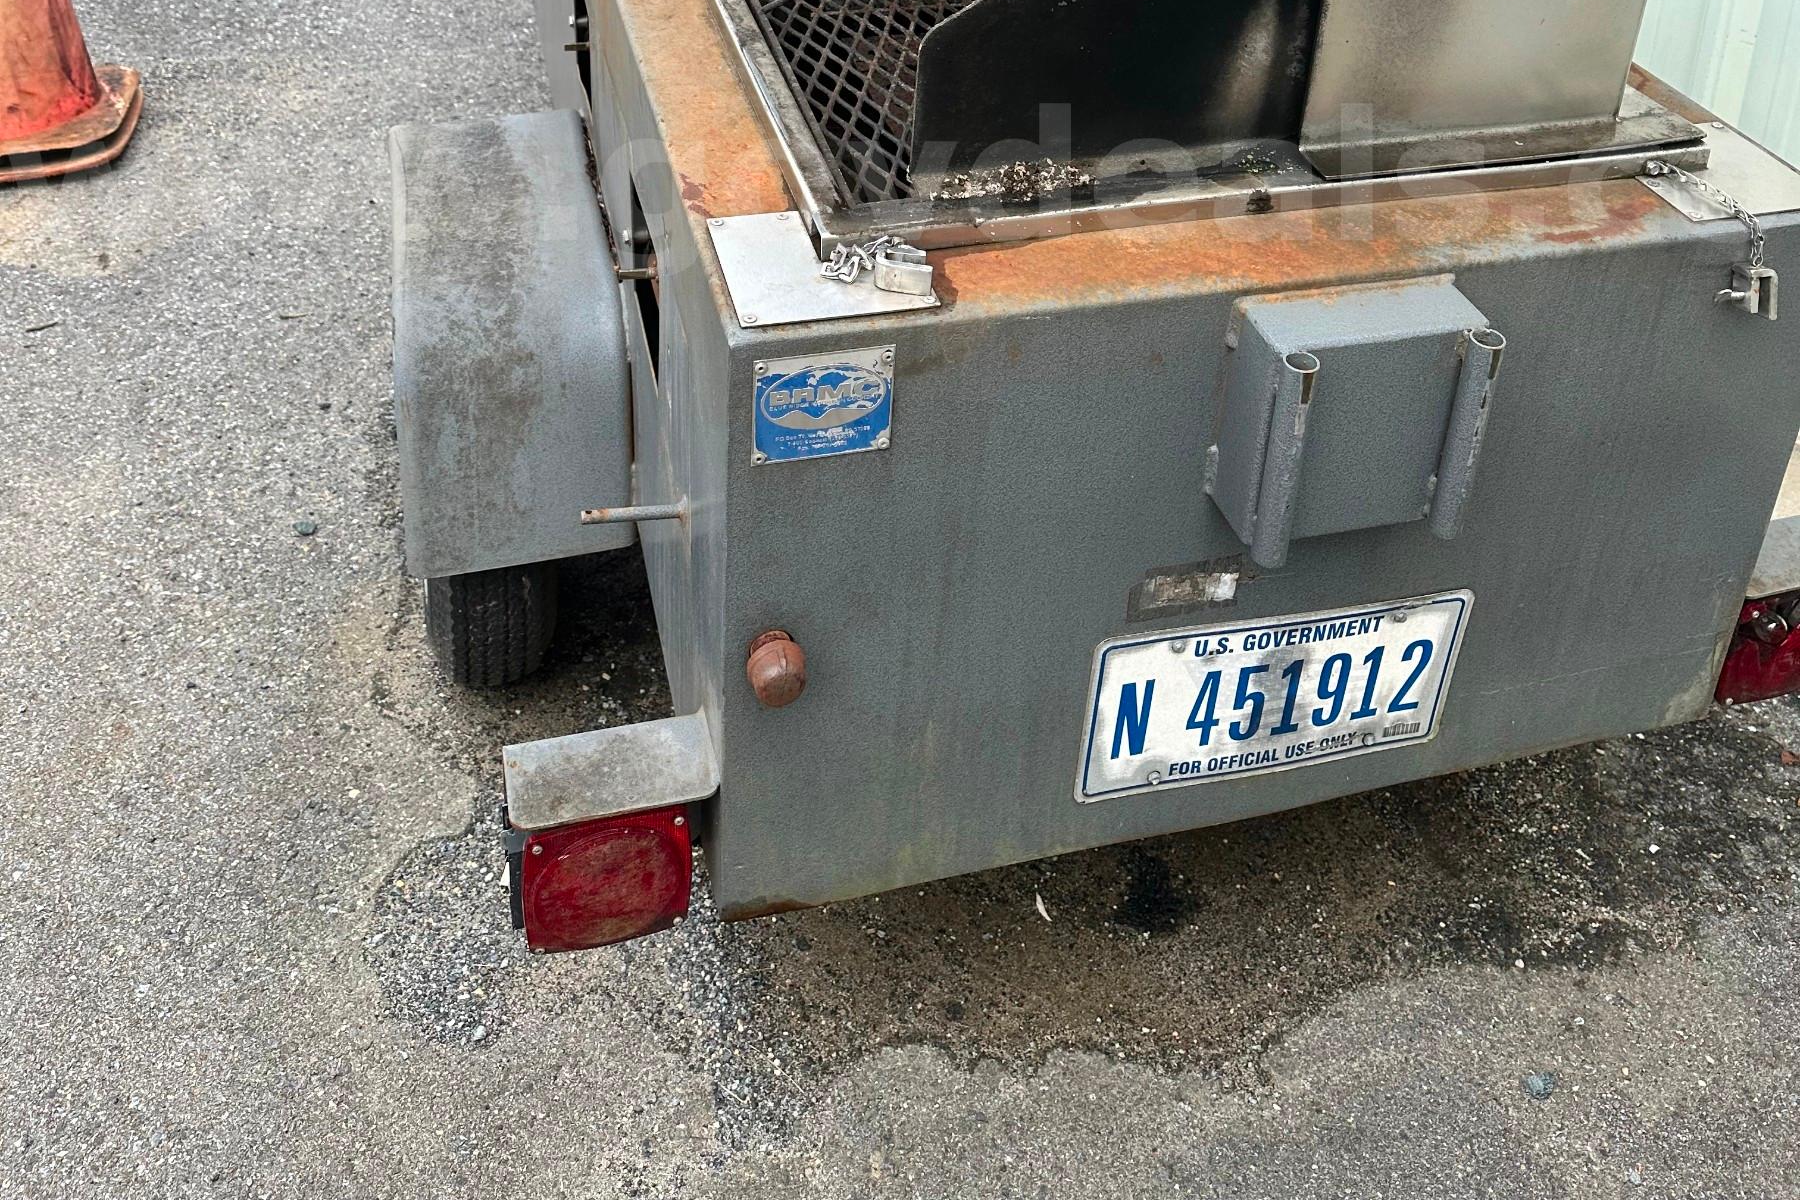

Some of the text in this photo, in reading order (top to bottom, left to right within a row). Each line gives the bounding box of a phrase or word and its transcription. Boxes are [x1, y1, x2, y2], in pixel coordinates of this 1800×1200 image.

[1194, 616, 1385, 657] U.S. GOVERNMENT
[1110, 639, 1435, 759] N 451912
[1168, 731, 1357, 776] FOR OFFICIAL USE ONLY
